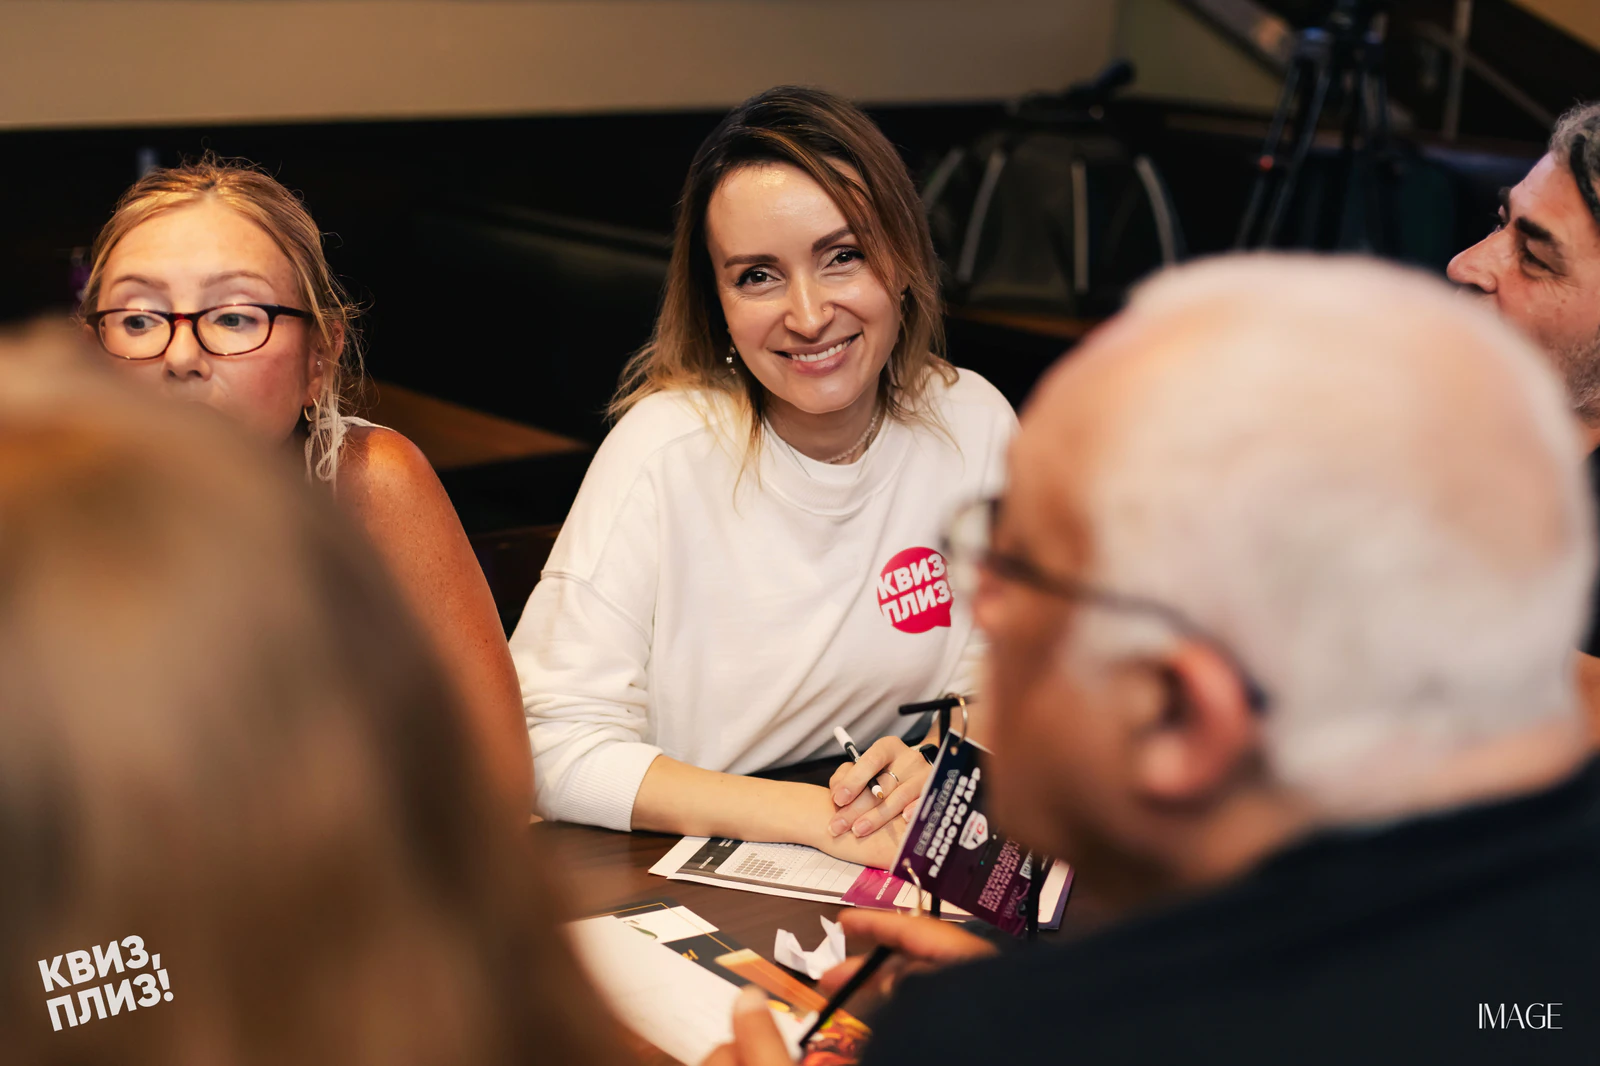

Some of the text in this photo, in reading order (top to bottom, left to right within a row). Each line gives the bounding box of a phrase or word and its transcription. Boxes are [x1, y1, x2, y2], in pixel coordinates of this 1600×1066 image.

[912, 769, 960, 856] DESCARGA
[925, 775, 969, 859] DEPORTES
[927, 824, 958, 877] RADIO
[964, 767, 979, 803] APP
